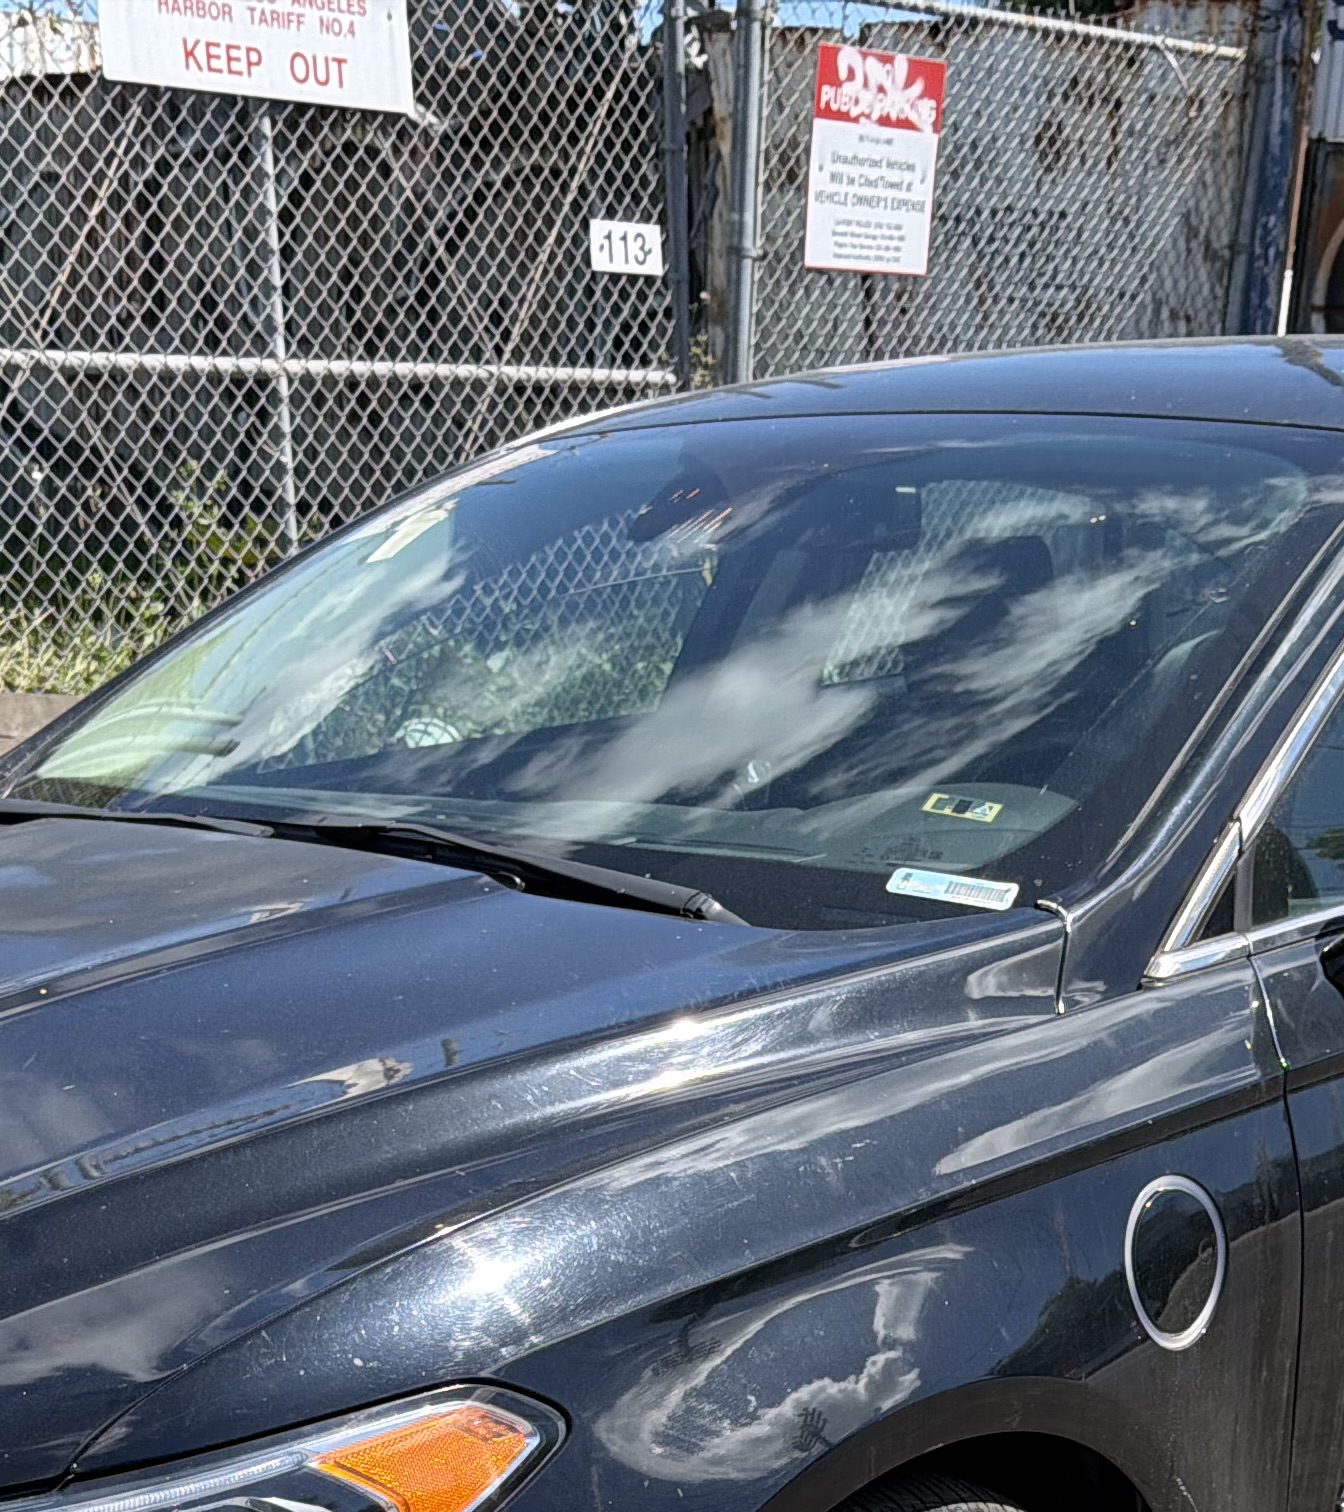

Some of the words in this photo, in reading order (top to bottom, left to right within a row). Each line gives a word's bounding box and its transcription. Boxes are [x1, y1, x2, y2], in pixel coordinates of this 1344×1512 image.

[157, 0, 234, 22] HARBOR
[246, 6, 306, 32] TARIFF
[181, 37, 263, 78] KEEP
[290, 51, 349, 89] OUT
[603, 228, 647, 266] 113
